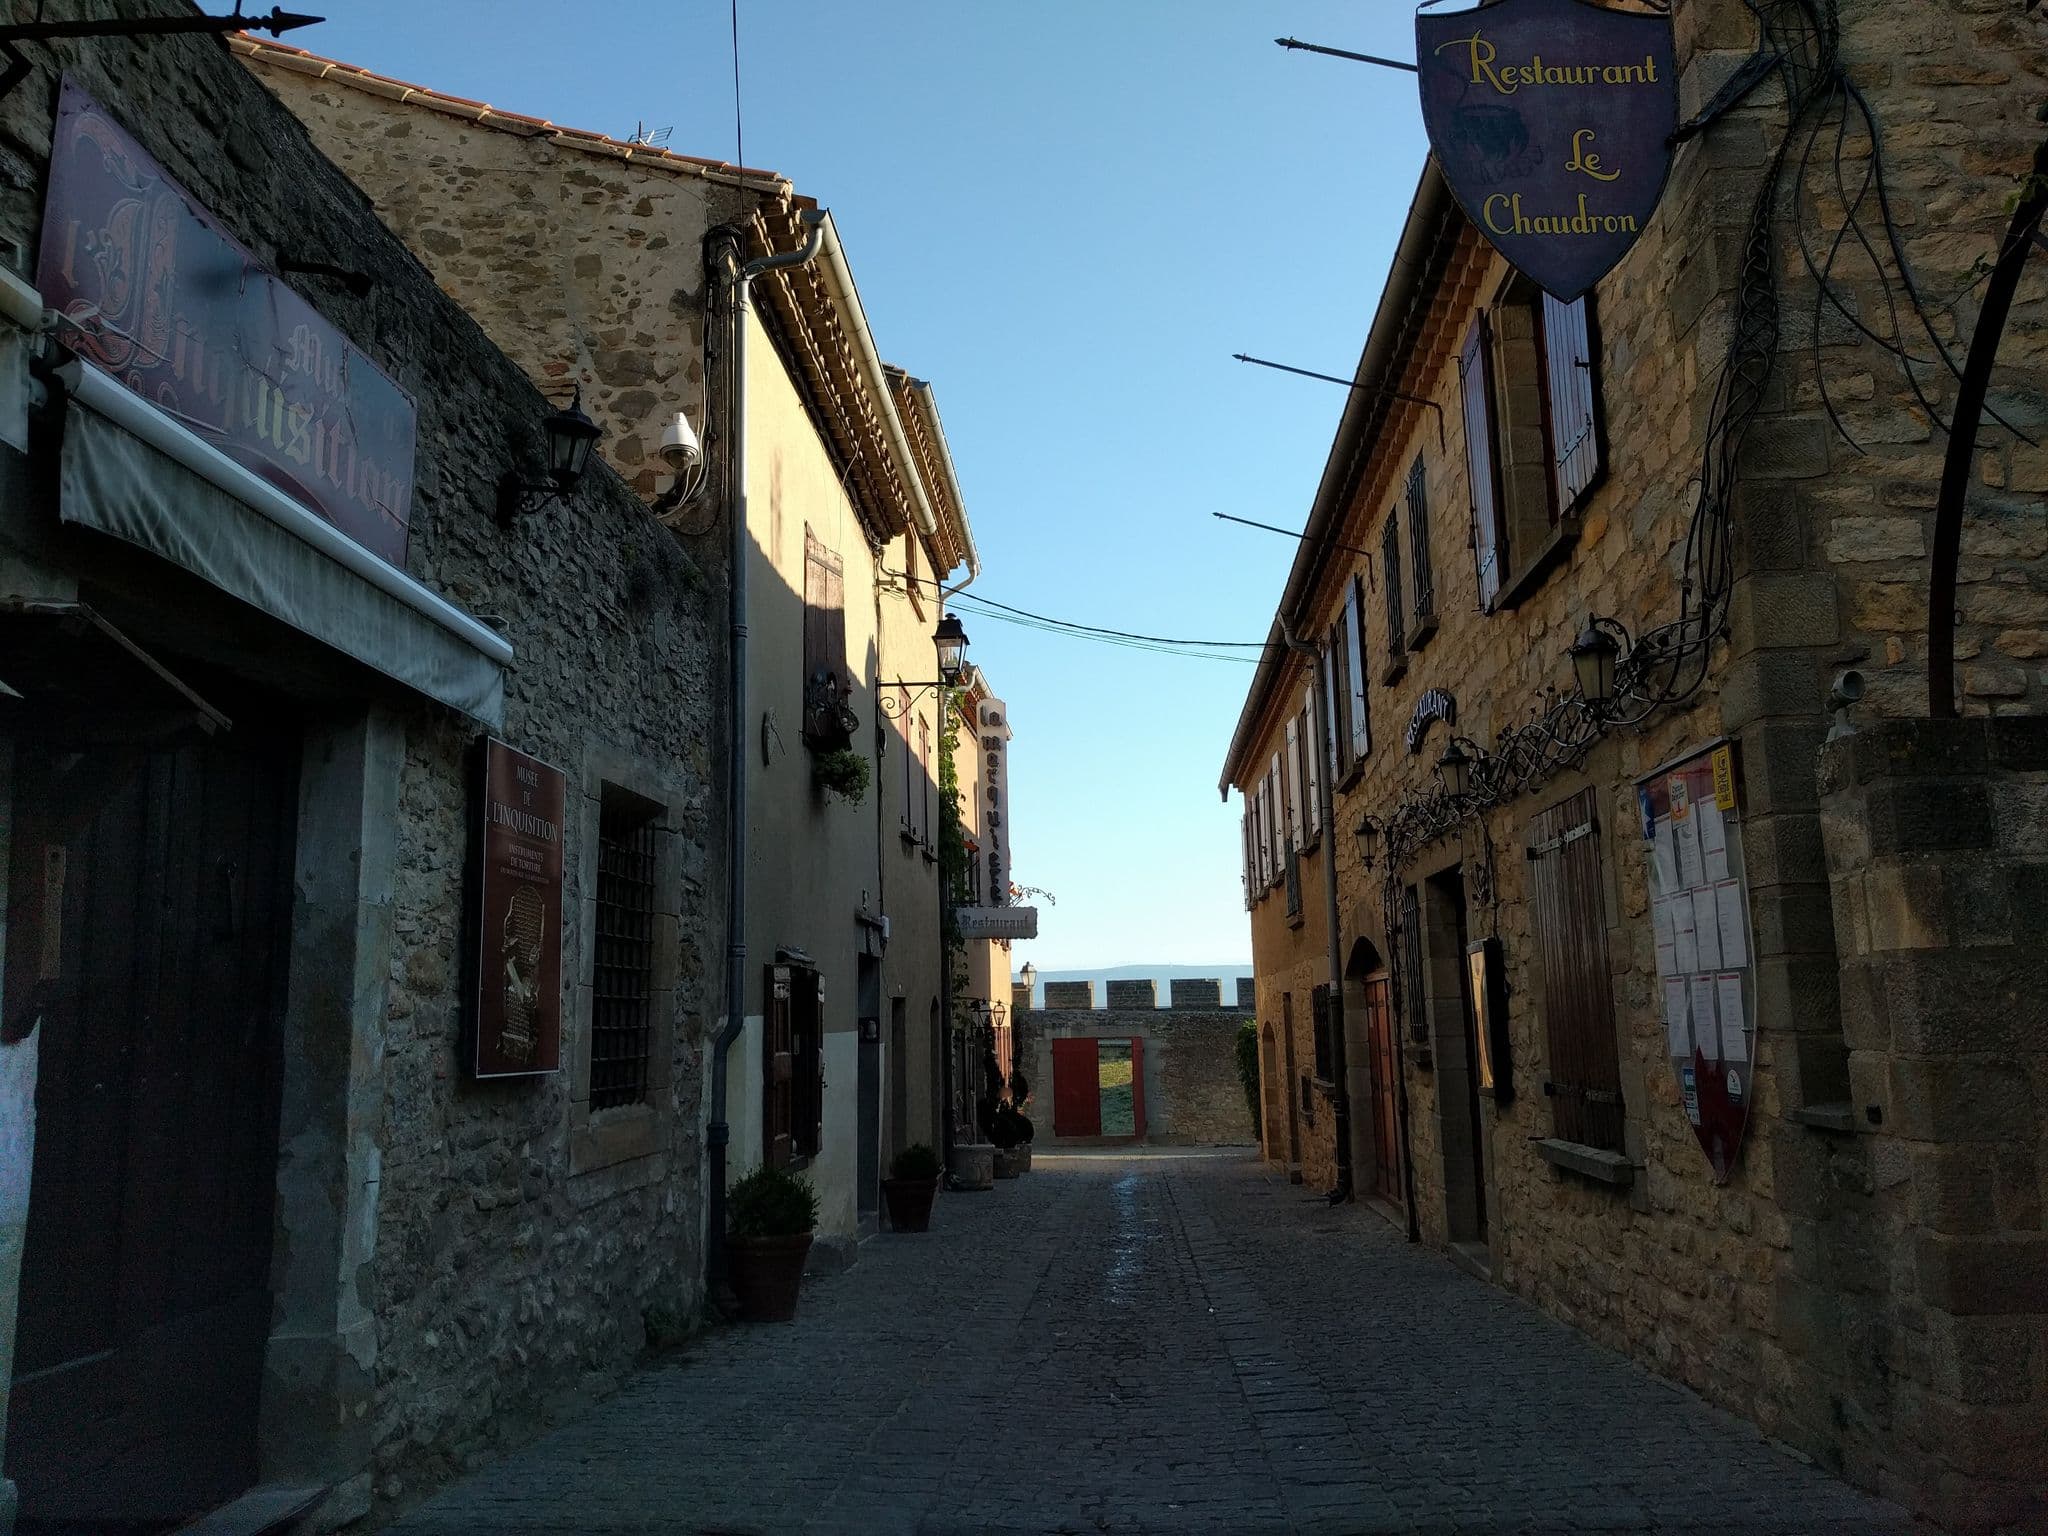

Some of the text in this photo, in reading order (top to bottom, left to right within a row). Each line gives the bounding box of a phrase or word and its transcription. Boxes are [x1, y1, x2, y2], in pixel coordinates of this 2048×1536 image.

[1433, 28, 1659, 95] Restaurant
[1564, 128, 1622, 182] Le
[1482, 191, 1639, 236] Chaudron
[523, 790, 531, 807] DE
[492, 801, 558, 843] L'INQUISITION
[508, 843, 545, 863] INSTRUMENTS
[958, 913, 1028, 930] Restaurant
